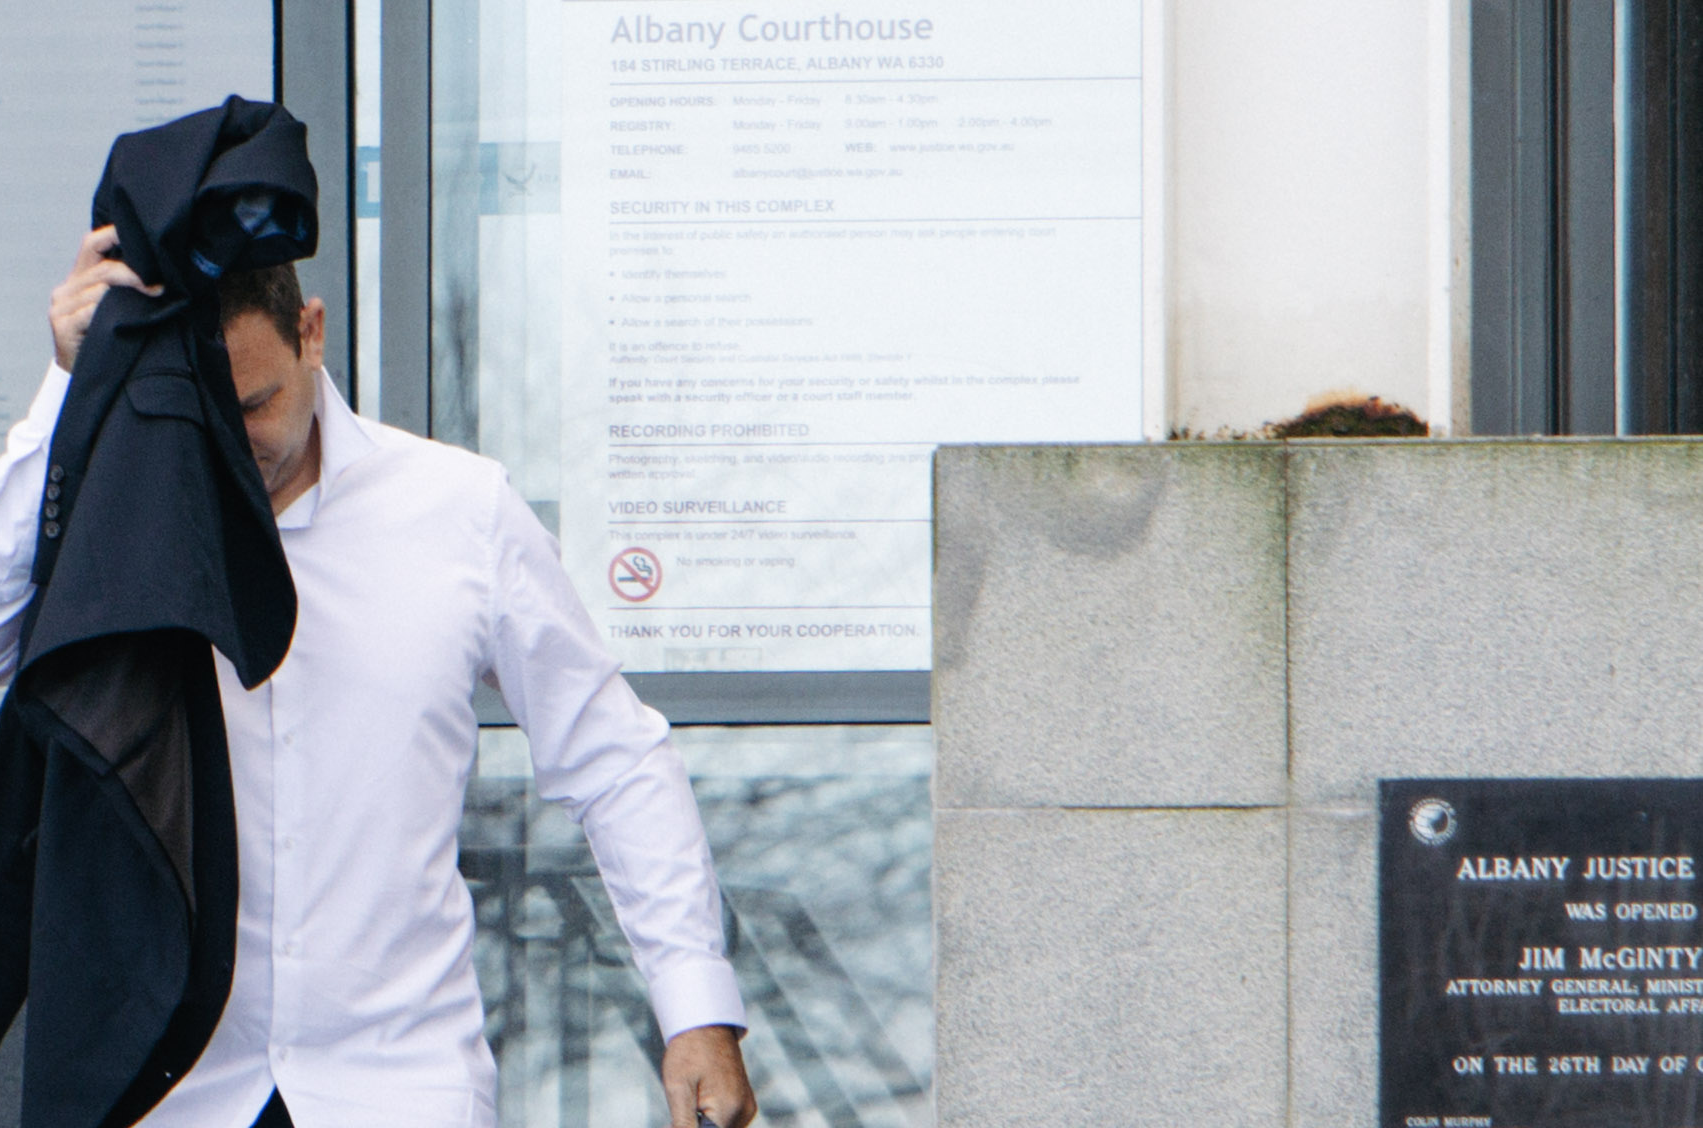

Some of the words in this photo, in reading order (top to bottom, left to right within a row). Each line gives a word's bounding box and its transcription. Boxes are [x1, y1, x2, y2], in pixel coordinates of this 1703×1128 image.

[610, 14, 726, 50] Albany
[738, 12, 934, 43] Courthouse
[611, 59, 636, 73] 184
[641, 58, 715, 73] STIRLING
[721, 56, 802, 73] TERRACE,
[806, 56, 873, 71] ALBANY
[878, 56, 904, 70] WA
[909, 55, 944, 70] 6330
[610, 97, 666, 108] OPENING
[733, 95, 777, 108] Monday
[787, 94, 822, 107] Friday
[733, 119, 777, 132] Monday
[787, 119, 822, 132] Friday
[610, 199, 689, 215] SECURITY
[694, 199, 710, 214] IN
[716, 199, 751, 214] THIS
[756, 198, 835, 214] COMPLEX
[619, 379, 641, 390] you
[608, 423, 706, 438] RECORDING
[710, 423, 810, 438] PROHIBITED
[608, 500, 658, 515] VIDEO
[662, 499, 787, 515] SURVEILLANCE
[677, 556, 693, 567] No
[609, 625, 663, 639] THANK
[668, 625, 703, 639] YOU
[708, 624, 741, 639] FOR
[746, 624, 793, 638] YOUR
[796, 623, 920, 638] COOPERATION.
[1456, 857, 1571, 881] ALBANY
[1583, 856, 1696, 880] JUSTICE
[1564, 902, 1608, 921] WAS
[1615, 902, 1699, 921] OPENED
[1518, 947, 1566, 971] JIM
[1579, 946, 1703, 970] McGINTY
[1446, 979, 1543, 996] ATTORNEY
[1558, 998, 1661, 1015] ELECTORAL
[1453, 1056, 1484, 1075] ON
[1493, 1056, 1538, 1075] THE
[1548, 1056, 1601, 1075] 26TH
[1612, 1056, 1649, 1075] DAY
[1659, 1056, 1688, 1075] OF
[1443, 1116, 1492, 1128] MURPHY
